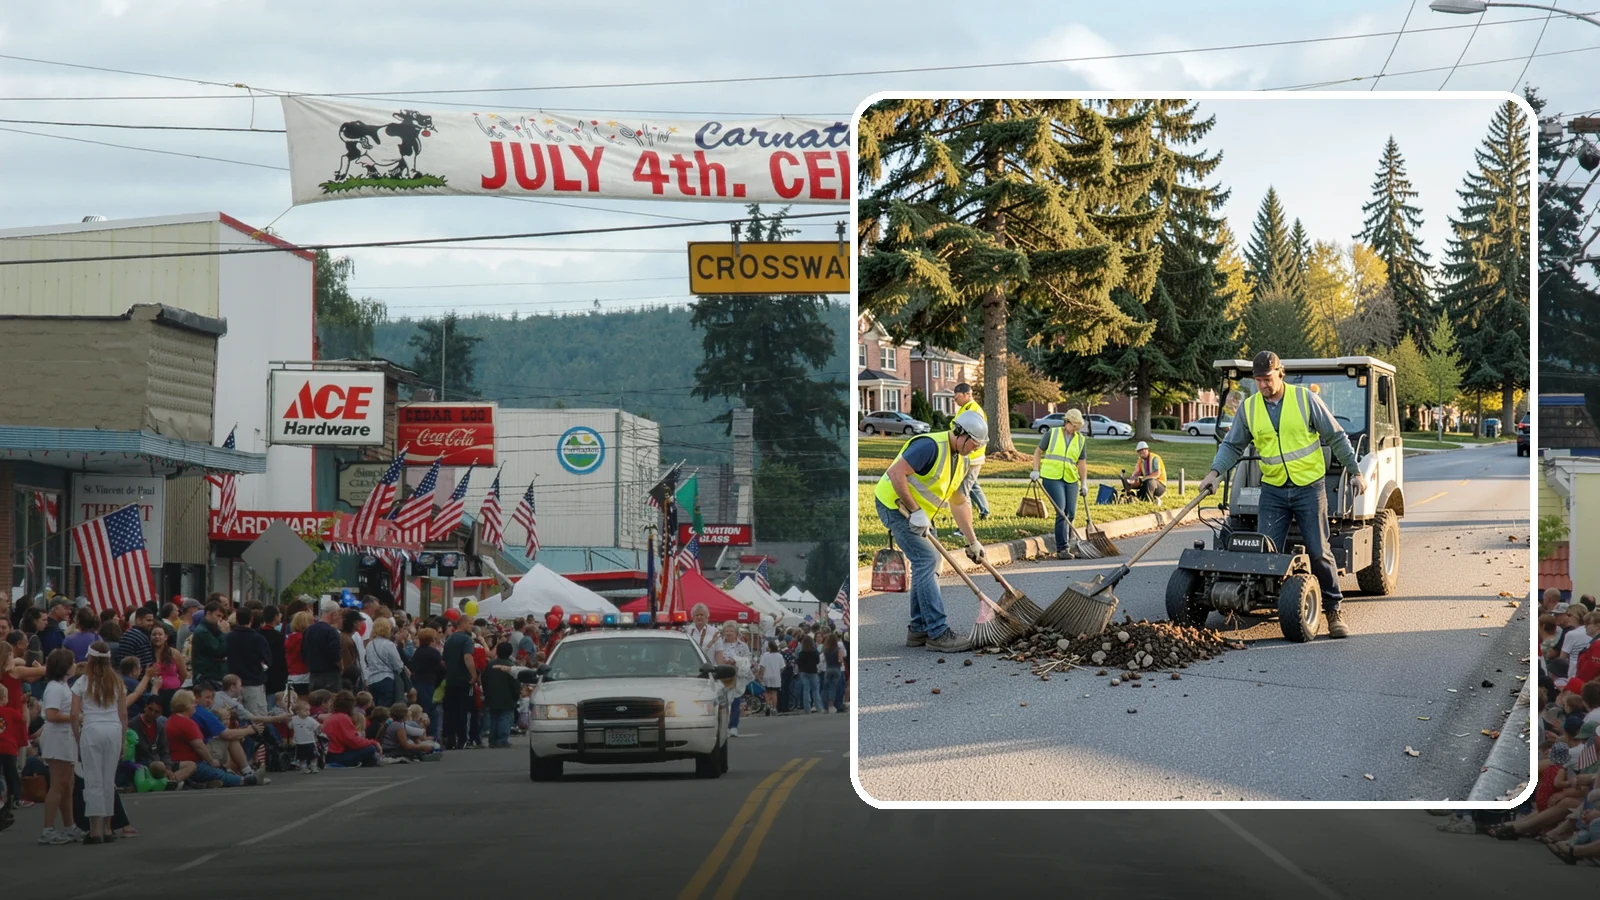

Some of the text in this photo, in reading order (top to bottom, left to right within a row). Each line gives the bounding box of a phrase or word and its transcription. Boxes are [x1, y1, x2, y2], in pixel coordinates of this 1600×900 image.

[481, 141, 605, 193] JULY
[632, 149, 746, 198] 4th.
[697, 254, 850, 280] CROSSWA
[283, 380, 373, 420] ACE
[405, 409, 452, 422] CEDAR
[283, 421, 371, 437] Hardware
[416, 428, 477, 447] Coca-Cola
[353, 467, 389, 480] Simpl
[83, 485, 155, 495] St. Vincent de Paul
[81, 503, 154, 522] THT
[688, 526, 741, 535] CRNATION
[699, 535, 730, 544] GLASS
